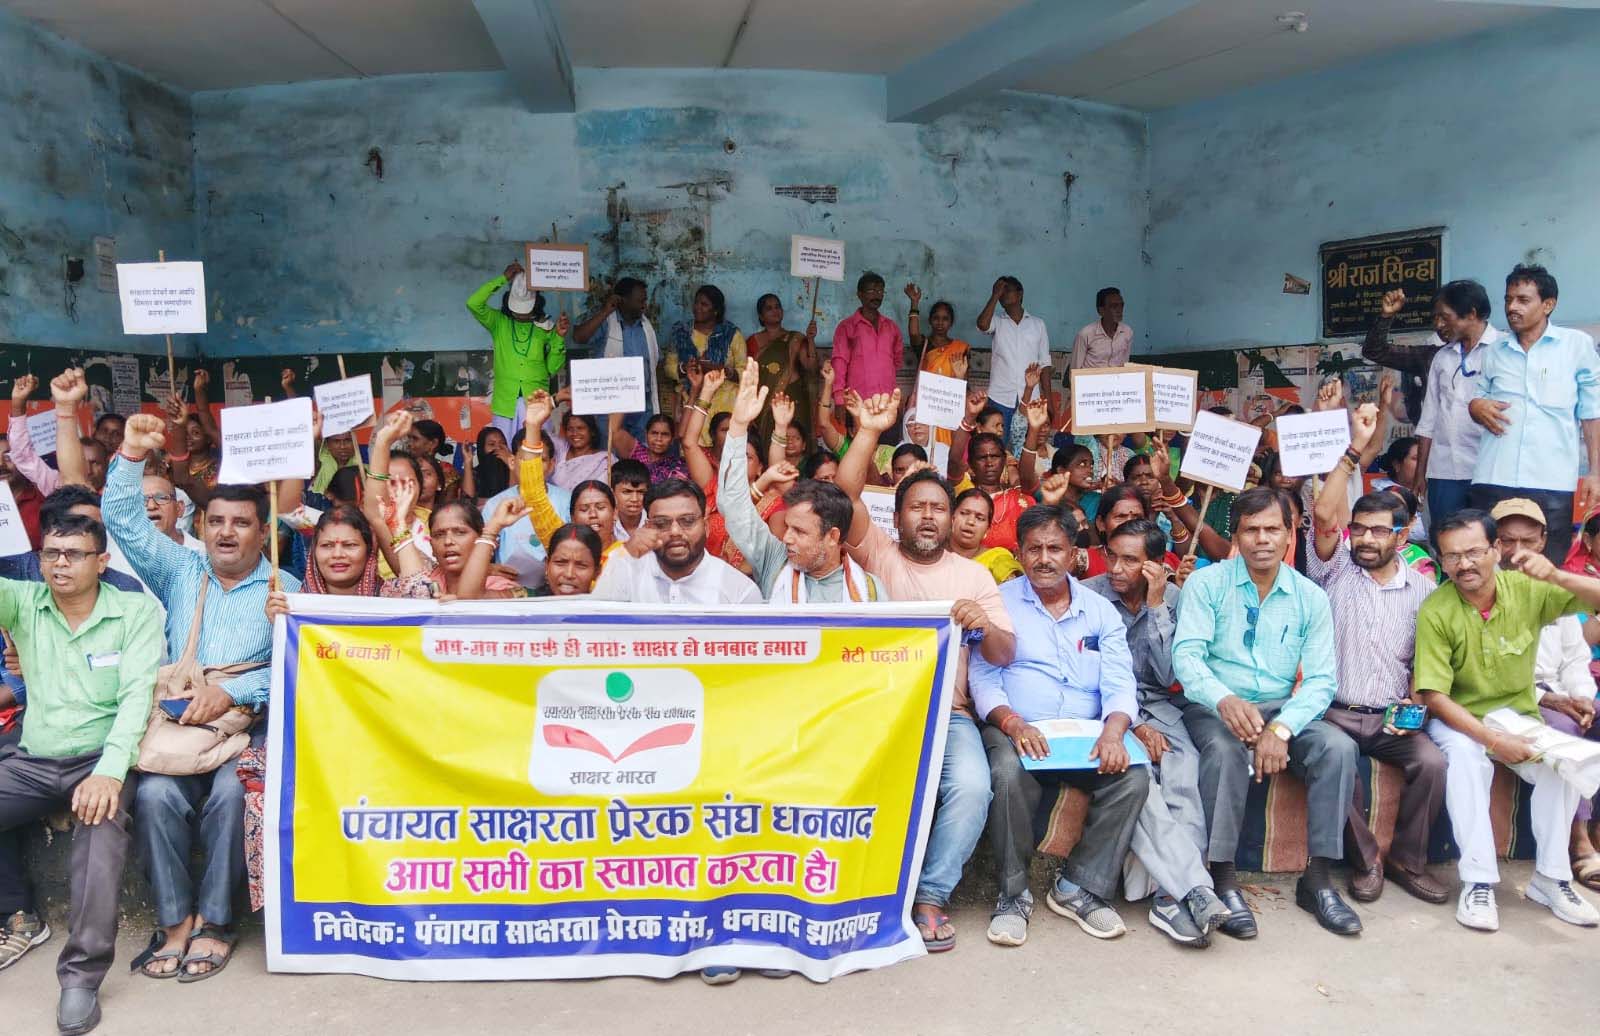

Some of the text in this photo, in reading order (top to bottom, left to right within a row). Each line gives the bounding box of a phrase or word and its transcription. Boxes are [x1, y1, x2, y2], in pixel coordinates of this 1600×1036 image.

[1327, 256, 1436, 288] श्री राज सिन्हा
[316, 641, 341, 660] बेटी
[503, 641, 525, 658] का
[564, 637, 581, 658] ही
[632, 640, 679, 657] साक्षर
[682, 636, 699, 658] हो
[704, 640, 759, 657] धनबाद
[763, 640, 808, 657] हमारा
[841, 645, 865, 663] बेटी
[569, 770, 657, 785] साक्षर भारत
[341, 793, 876, 843] पंचायत साक्षरता प्रेरक संघ धनबाद
[386, 849, 839, 894] आप सभी का स्वागत करता है।
[414, 914, 500, 946] पंचायत
[504, 916, 601, 945] साक्षरता
[605, 908, 663, 942] प्रेरक
[667, 909, 715, 942] संघ,
[722, 908, 802, 938] धनबाद
[805, 911, 882, 946] झारखण्ड
